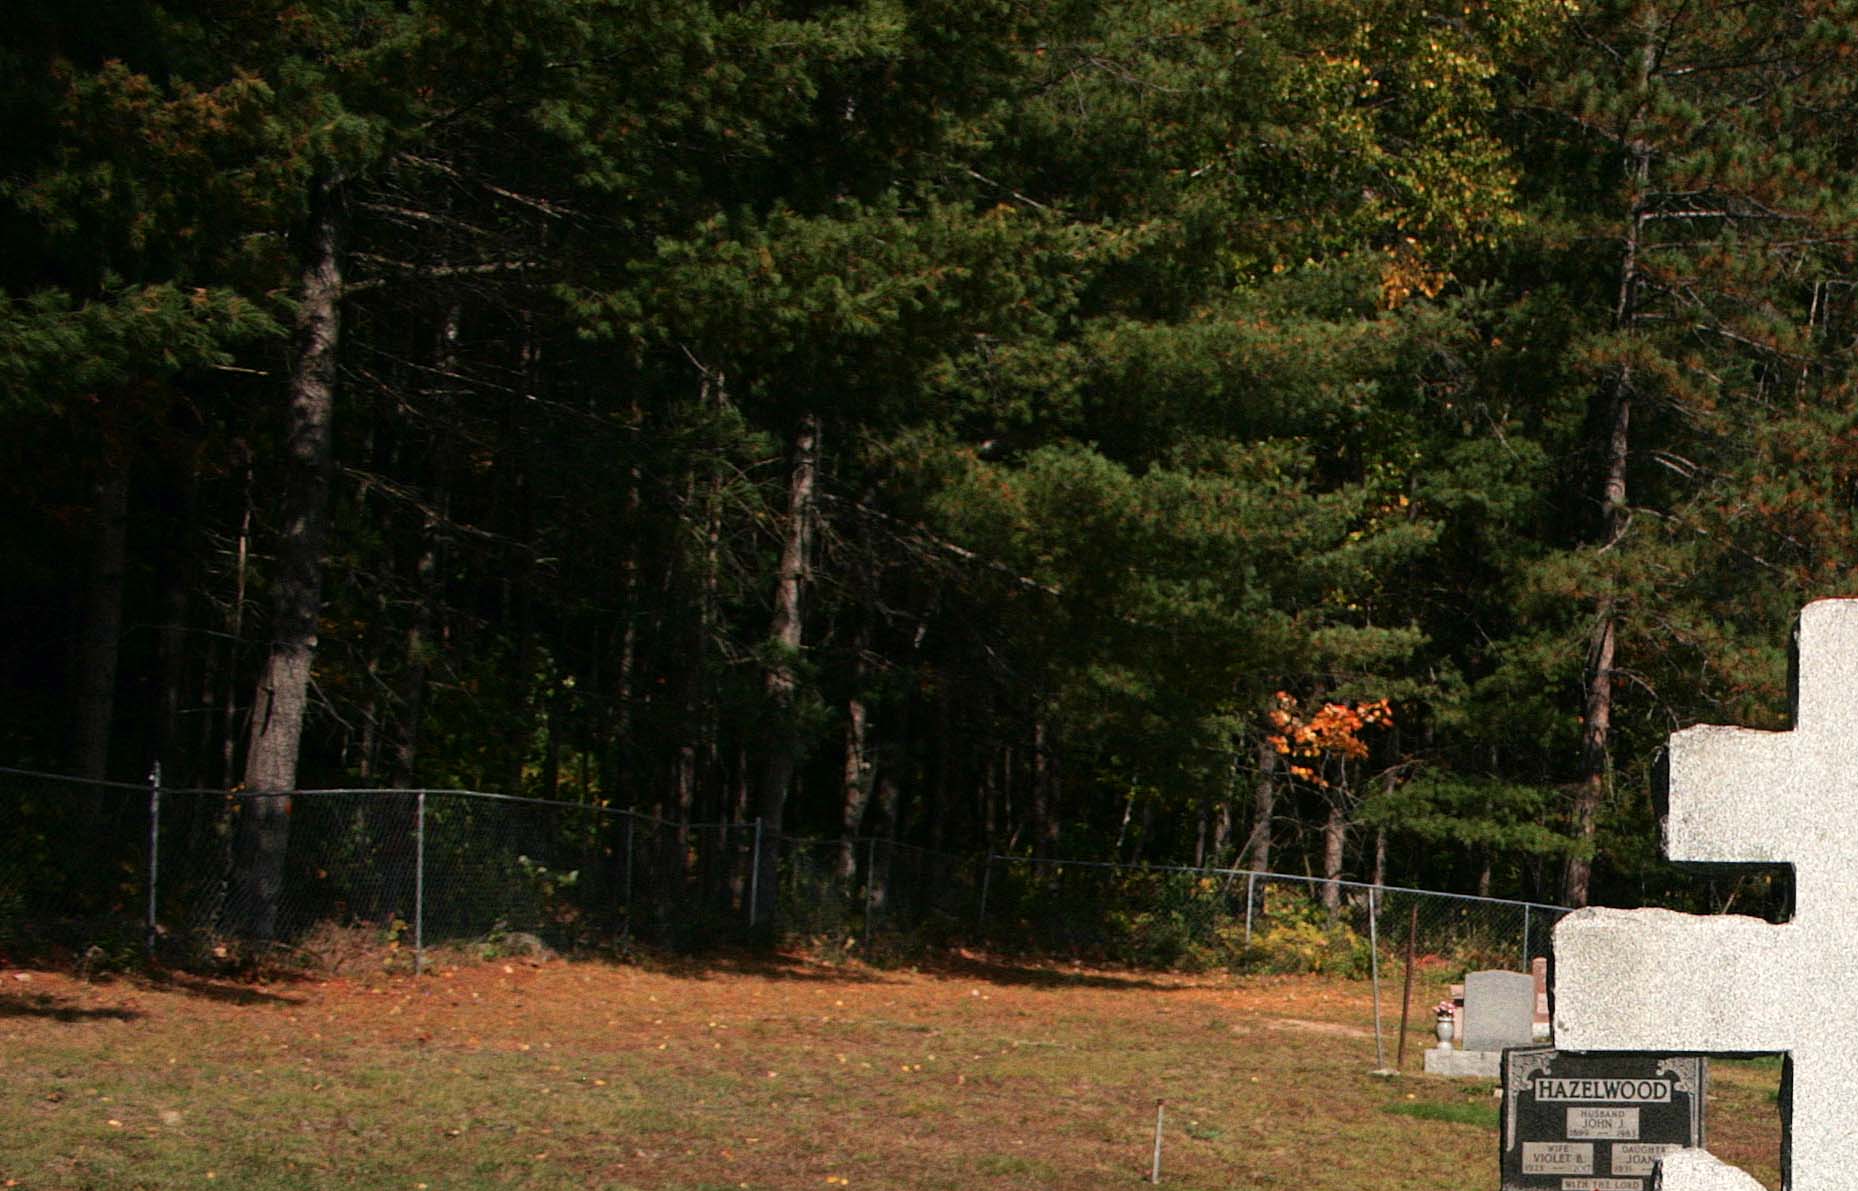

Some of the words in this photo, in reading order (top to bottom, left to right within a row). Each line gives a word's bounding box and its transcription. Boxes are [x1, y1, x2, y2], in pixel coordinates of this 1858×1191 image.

[1539, 1081, 1667, 1099] HAZELWOOD
[1582, 1119, 1613, 1129] JOHN
[1533, 1154, 1571, 1164] VIOLET
